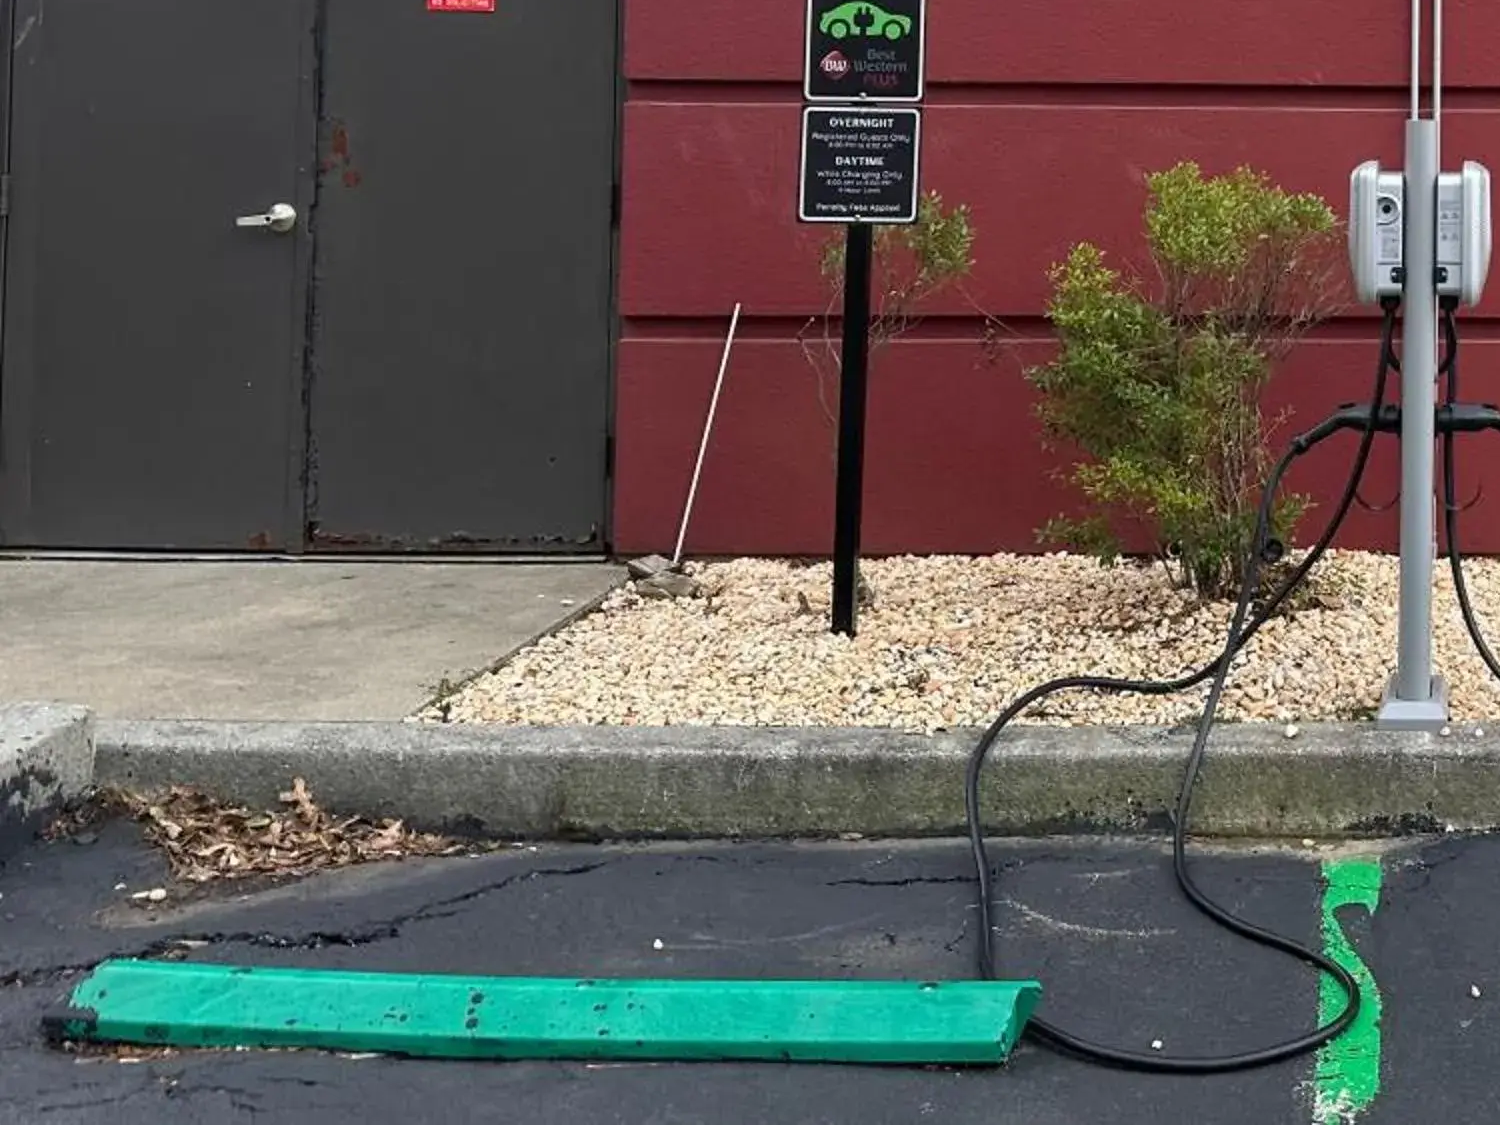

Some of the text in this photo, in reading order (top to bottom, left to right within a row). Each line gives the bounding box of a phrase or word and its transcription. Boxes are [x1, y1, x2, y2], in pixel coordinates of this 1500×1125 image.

[853, 59, 908, 73] Western
[829, 118, 895, 128] OVERNIGHT
[835, 156, 885, 166] DAYTIME
